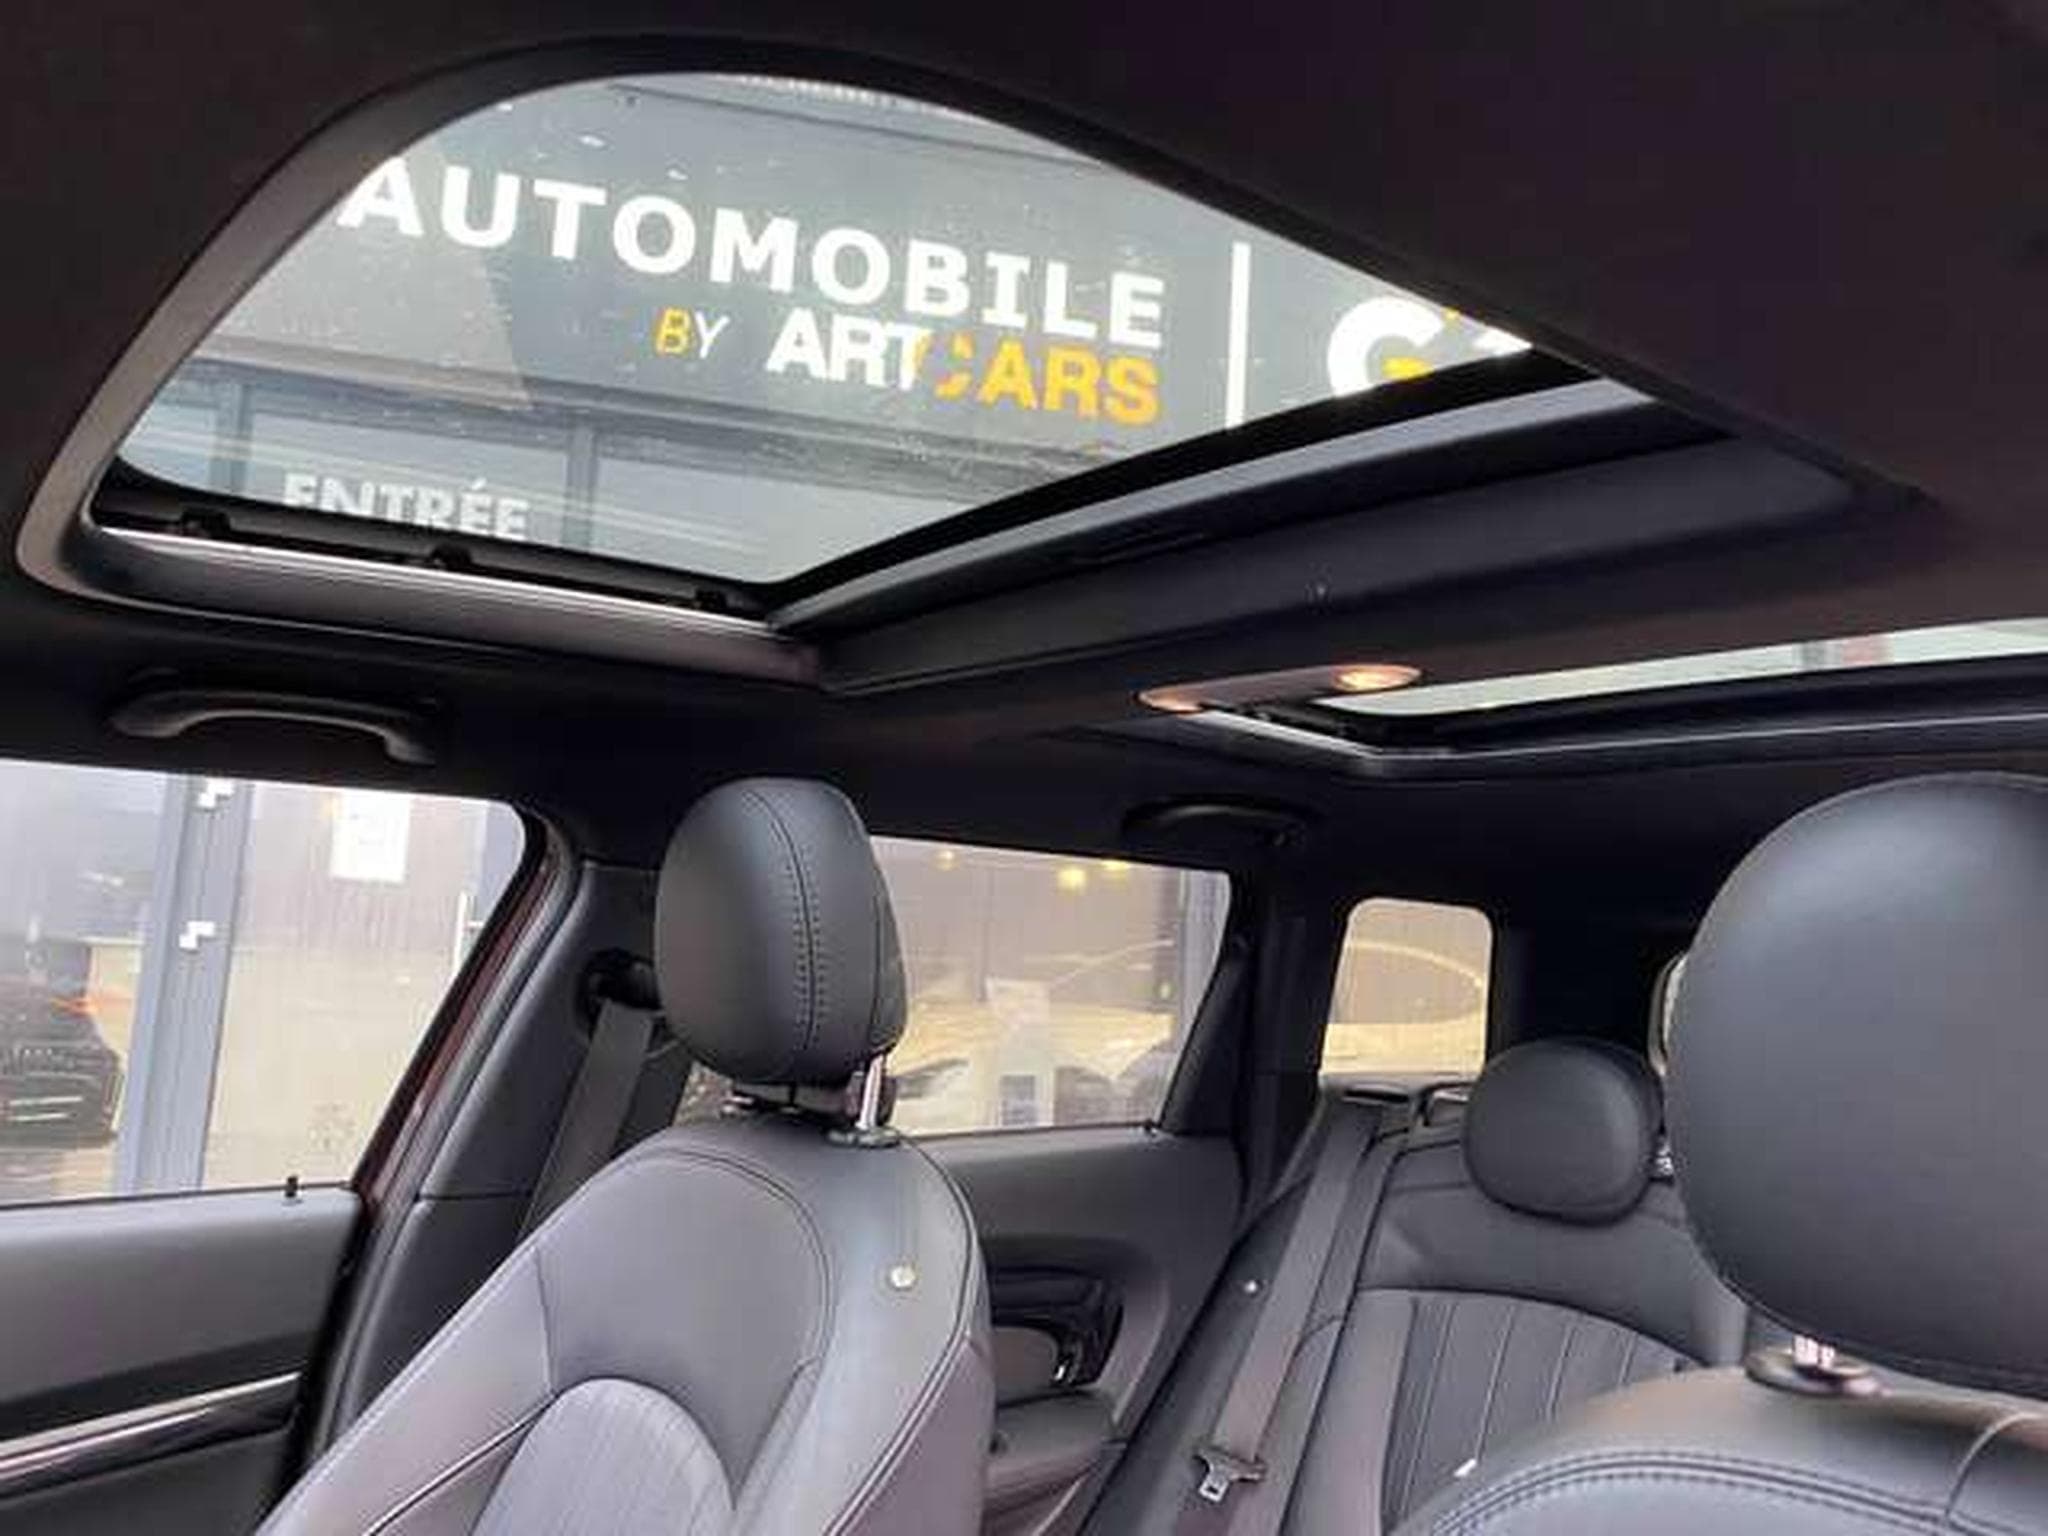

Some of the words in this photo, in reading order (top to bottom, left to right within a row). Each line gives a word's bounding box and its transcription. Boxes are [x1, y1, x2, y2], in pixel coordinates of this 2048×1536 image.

[336, 155, 1165, 350] AUTOMOBILE
[654, 307, 730, 360] BY
[283, 472, 530, 540] ENTRÉE
